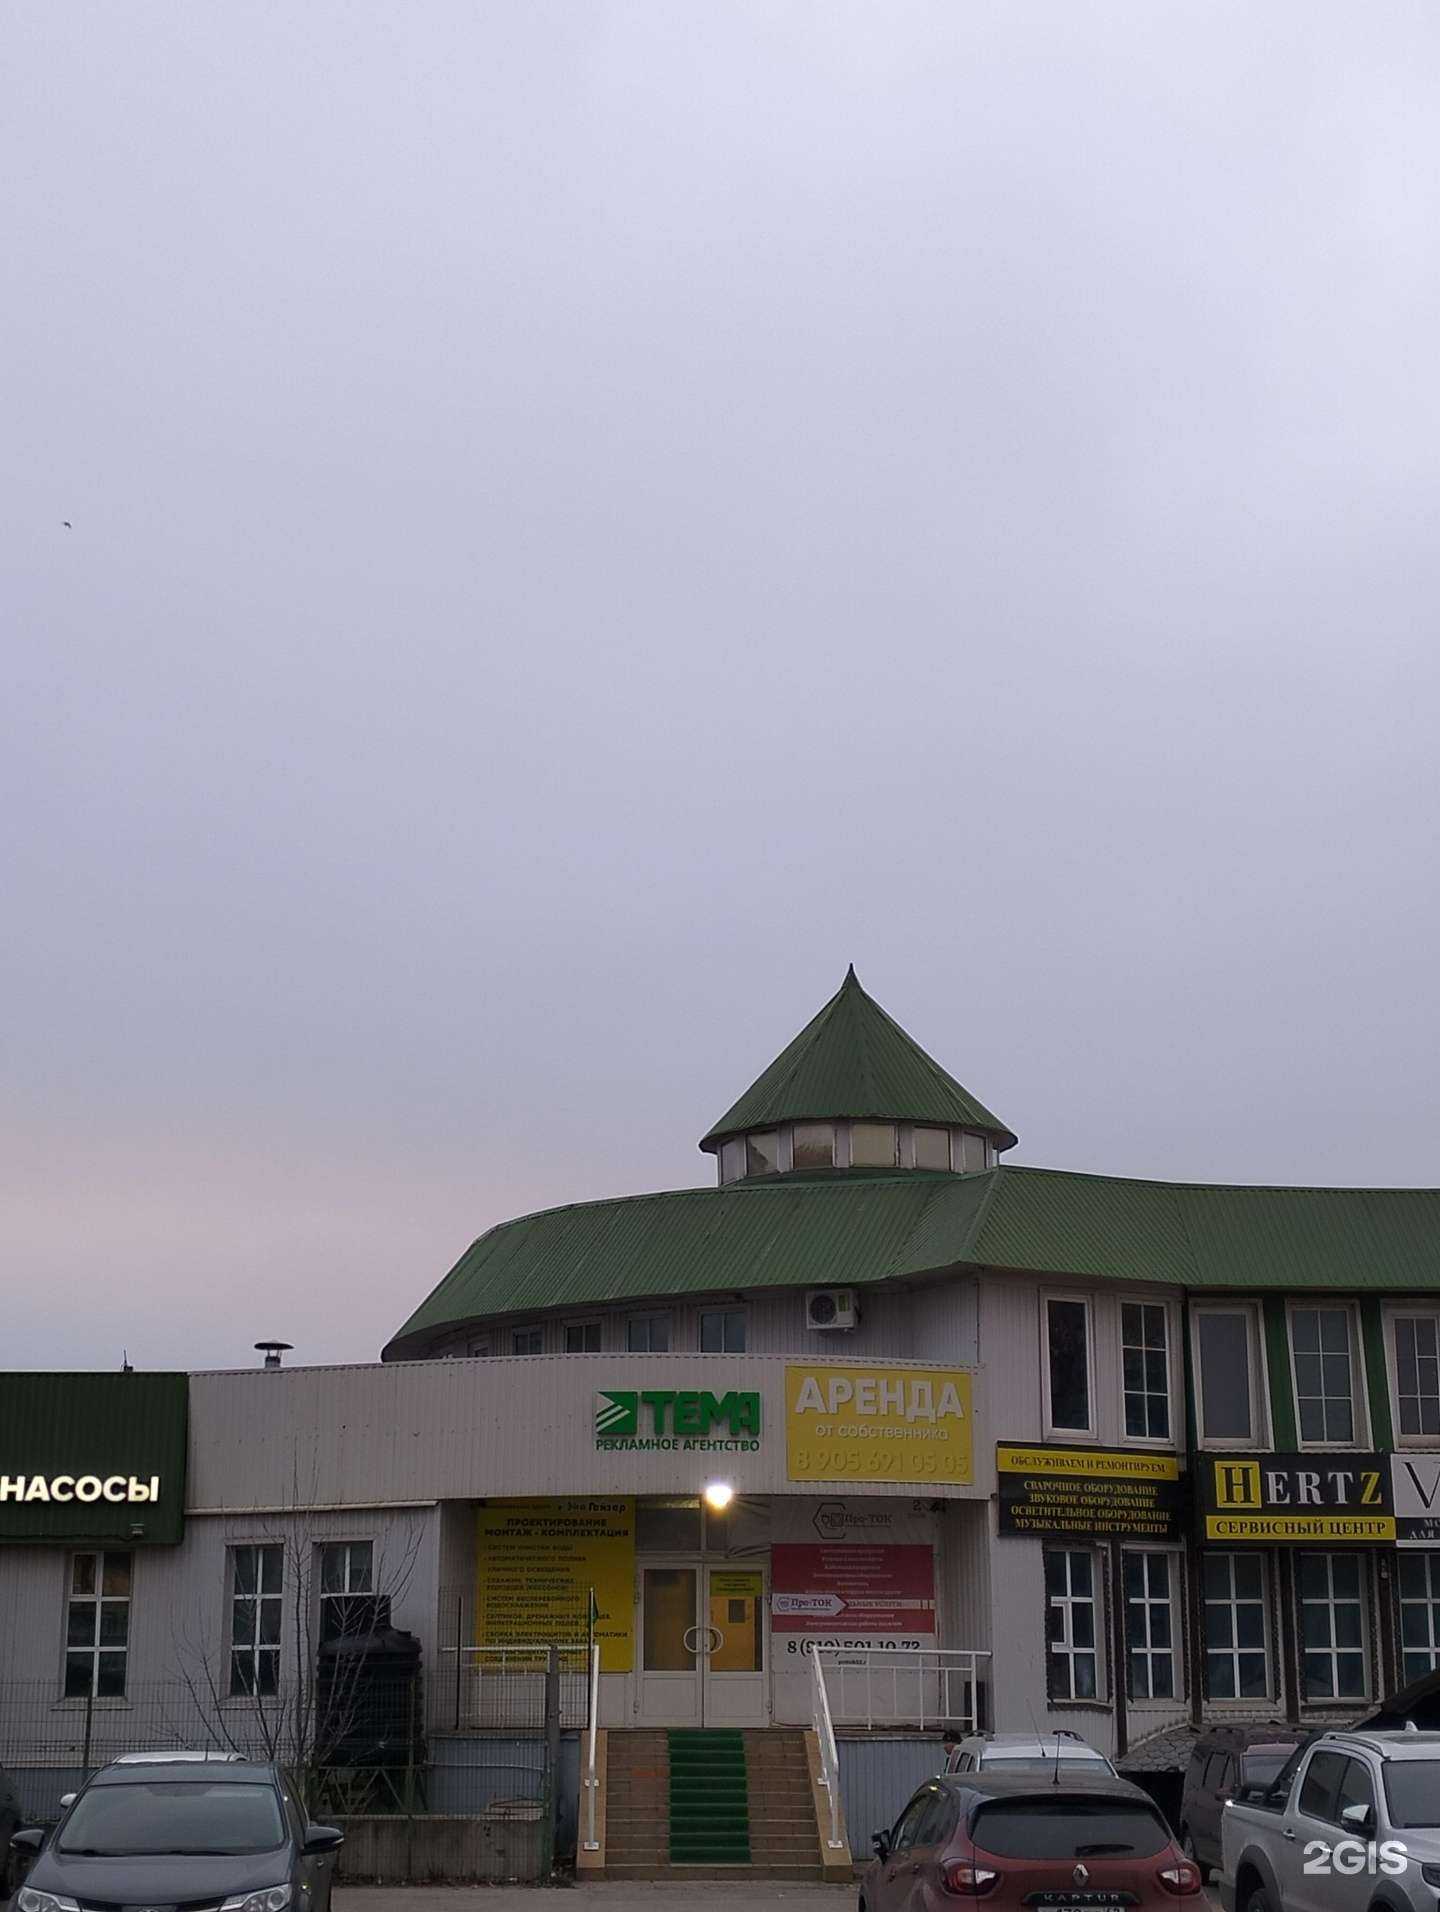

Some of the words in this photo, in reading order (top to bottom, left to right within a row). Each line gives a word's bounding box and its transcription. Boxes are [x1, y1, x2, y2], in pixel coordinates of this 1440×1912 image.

[795, 1376, 964, 1423] АРЕНДА
[641, 1391, 761, 1435] ТЕМА
[816, 1425, 833, 1437] от
[838, 1424, 949, 1441] собственника
[596, 1438, 679, 1451] РЕКЛАМНОЕ
[683, 1440, 761, 1452] АГЕНТСТВО
[797, 1451, 811, 1472] 8
[816, 1451, 861, 1473] 905
[1011, 1455, 1085, 1469] ОБСЛУЖИВАЕМ
[1086, 1459, 1094, 1469] И
[1096, 1459, 1168, 1473] РЕМОНТИРУЕМ
[0, 1475, 159, 1502] НАСОСЫ
[1024, 1480, 1083, 1493] СВАРОЧНОЕ
[1084, 1483, 1158, 1496] ОБОРУДОВАНИЕ
[1221, 1466, 1382, 1505] HERTZ
[1029, 1493, 1080, 1505] ЗВУКОВОЕ
[1080, 1496, 1155, 1508] ОБОРУДОВАНИЕ
[1011, 1506, 1095, 1519] ОСВЕТИТЕЛЬНОЕ
[1097, 1509, 1171, 1521] ОБОРУДОВАНИЕ
[507, 1518, 607, 1527] ПРОЕКТИРОВАНИЕ
[1015, 1518, 1093, 1531] МУЗЫКАЛЬНЫЕ
[1094, 1521, 1168, 1534] ИНСТРУМЕНТЫ
[1216, 1518, 1325, 1535] СЕРВИСНЫЙ
[1330, 1520, 1386, 1536] ЦЕНТР
[485, 1529, 532, 1537] МОНТАЖ
[541, 1528, 629, 1538] КОМПЛЕКТАЦИЯ
[791, 1599, 833, 1608] Про-ТОК
[787, 1640, 797, 1654] 8
[1044, 1894, 1119, 1902] KAPTUR
